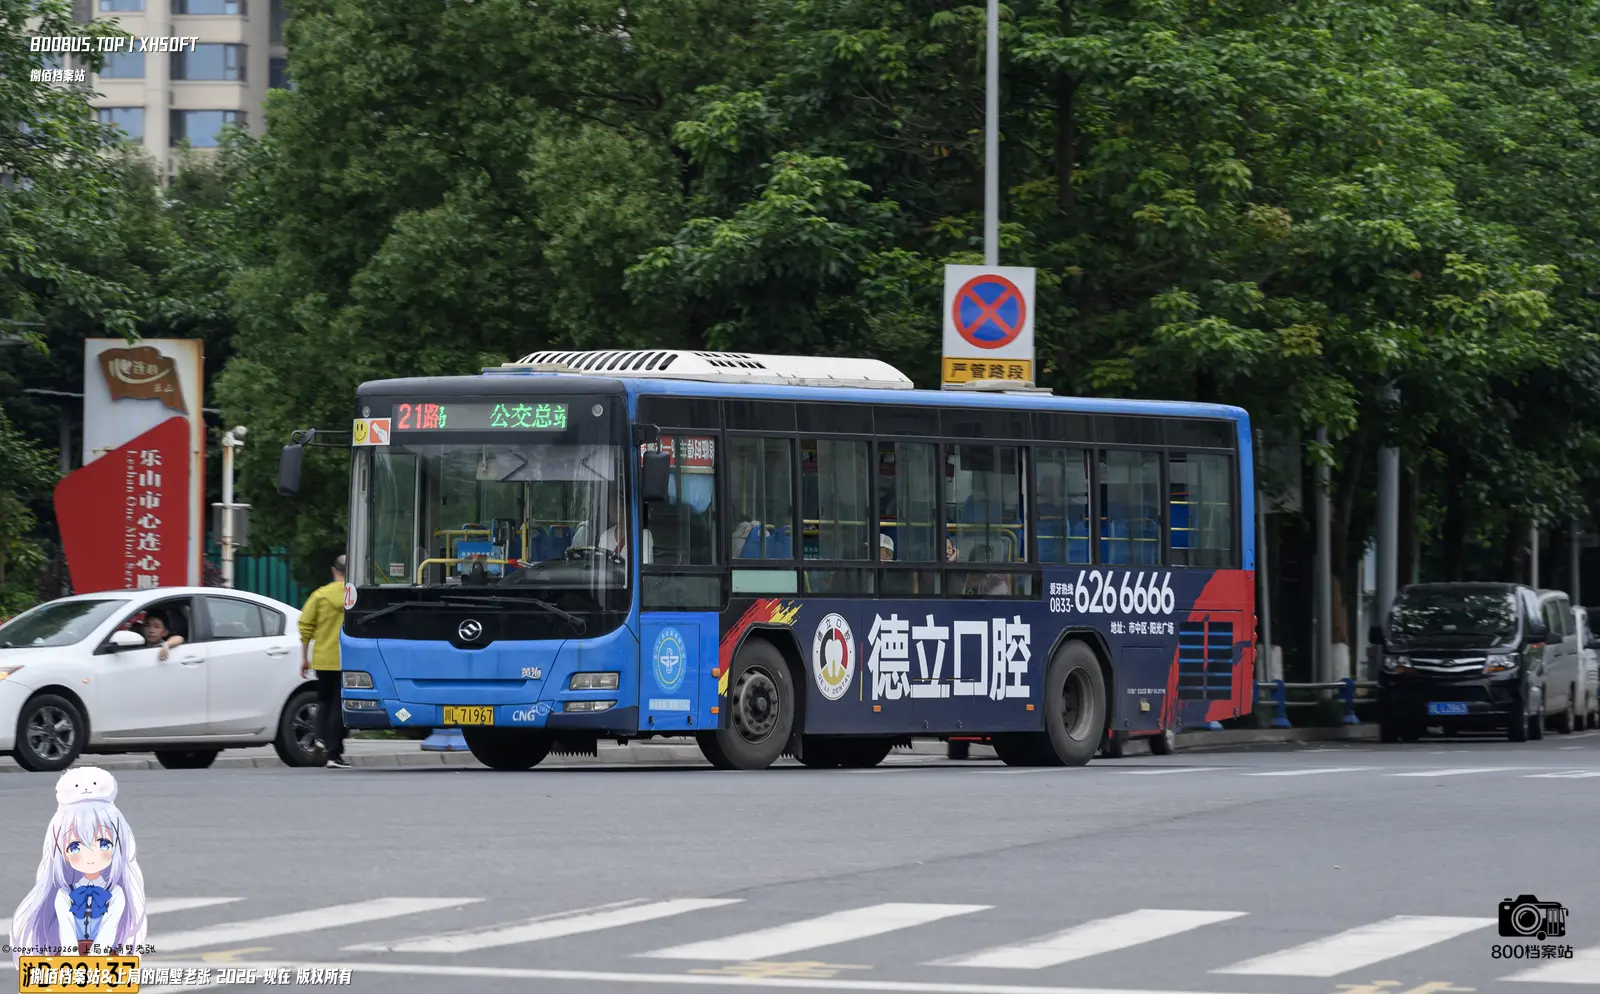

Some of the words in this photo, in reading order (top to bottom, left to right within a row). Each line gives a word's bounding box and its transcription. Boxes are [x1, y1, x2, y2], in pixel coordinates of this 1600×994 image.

[950, 362, 1025, 380] 严管路段
[126, 449, 138, 493] Leshan
[125, 496, 137, 521] One
[125, 526, 137, 558] Mind
[1049, 582, 1074, 595] 爱牙热线
[867, 612, 1032, 701] 德立口腔
[512, 709, 536, 722] CNG
